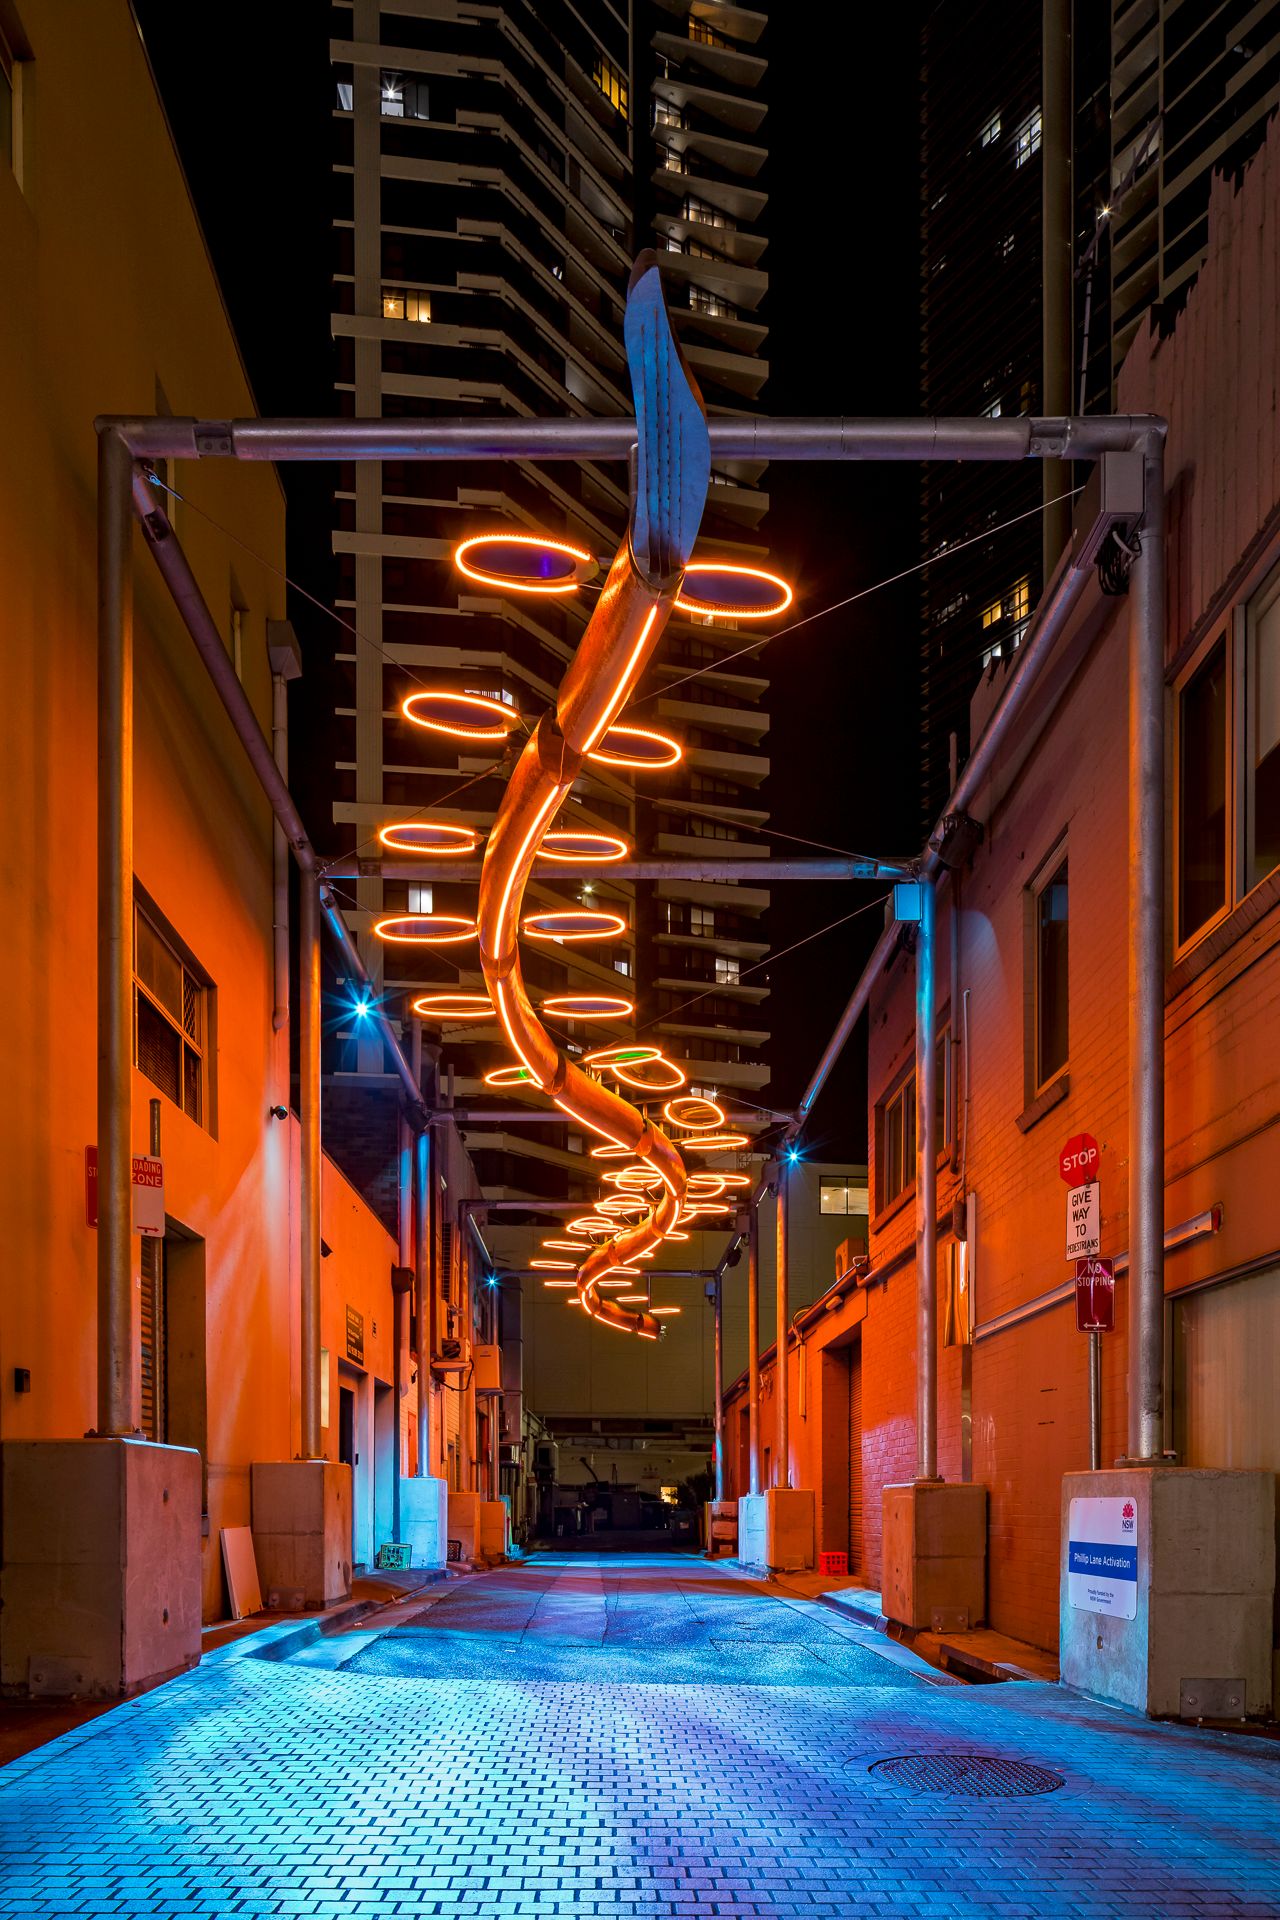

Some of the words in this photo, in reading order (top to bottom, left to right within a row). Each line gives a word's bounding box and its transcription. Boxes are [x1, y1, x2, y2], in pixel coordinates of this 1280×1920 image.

[1063, 1148, 1097, 1171] STOP
[131, 1160, 161, 1174] OADING
[131, 1172, 162, 1186] ZONE
[1071, 1190, 1092, 1207] GIVE
[1072, 1206, 1090, 1222] WAY
[1075, 1223, 1087, 1237] TO
[1067, 1238, 1099, 1254] PEDESTRIANS
[1087, 1262, 1102, 1274] NO
[1078, 1275, 1113, 1287] STOPPING
[1122, 1520, 1134, 1529] NSW
[1074, 1552, 1089, 1565] Phillip
[1089, 1554, 1102, 1565] Lane
[1103, 1556, 1131, 1569] Activation
